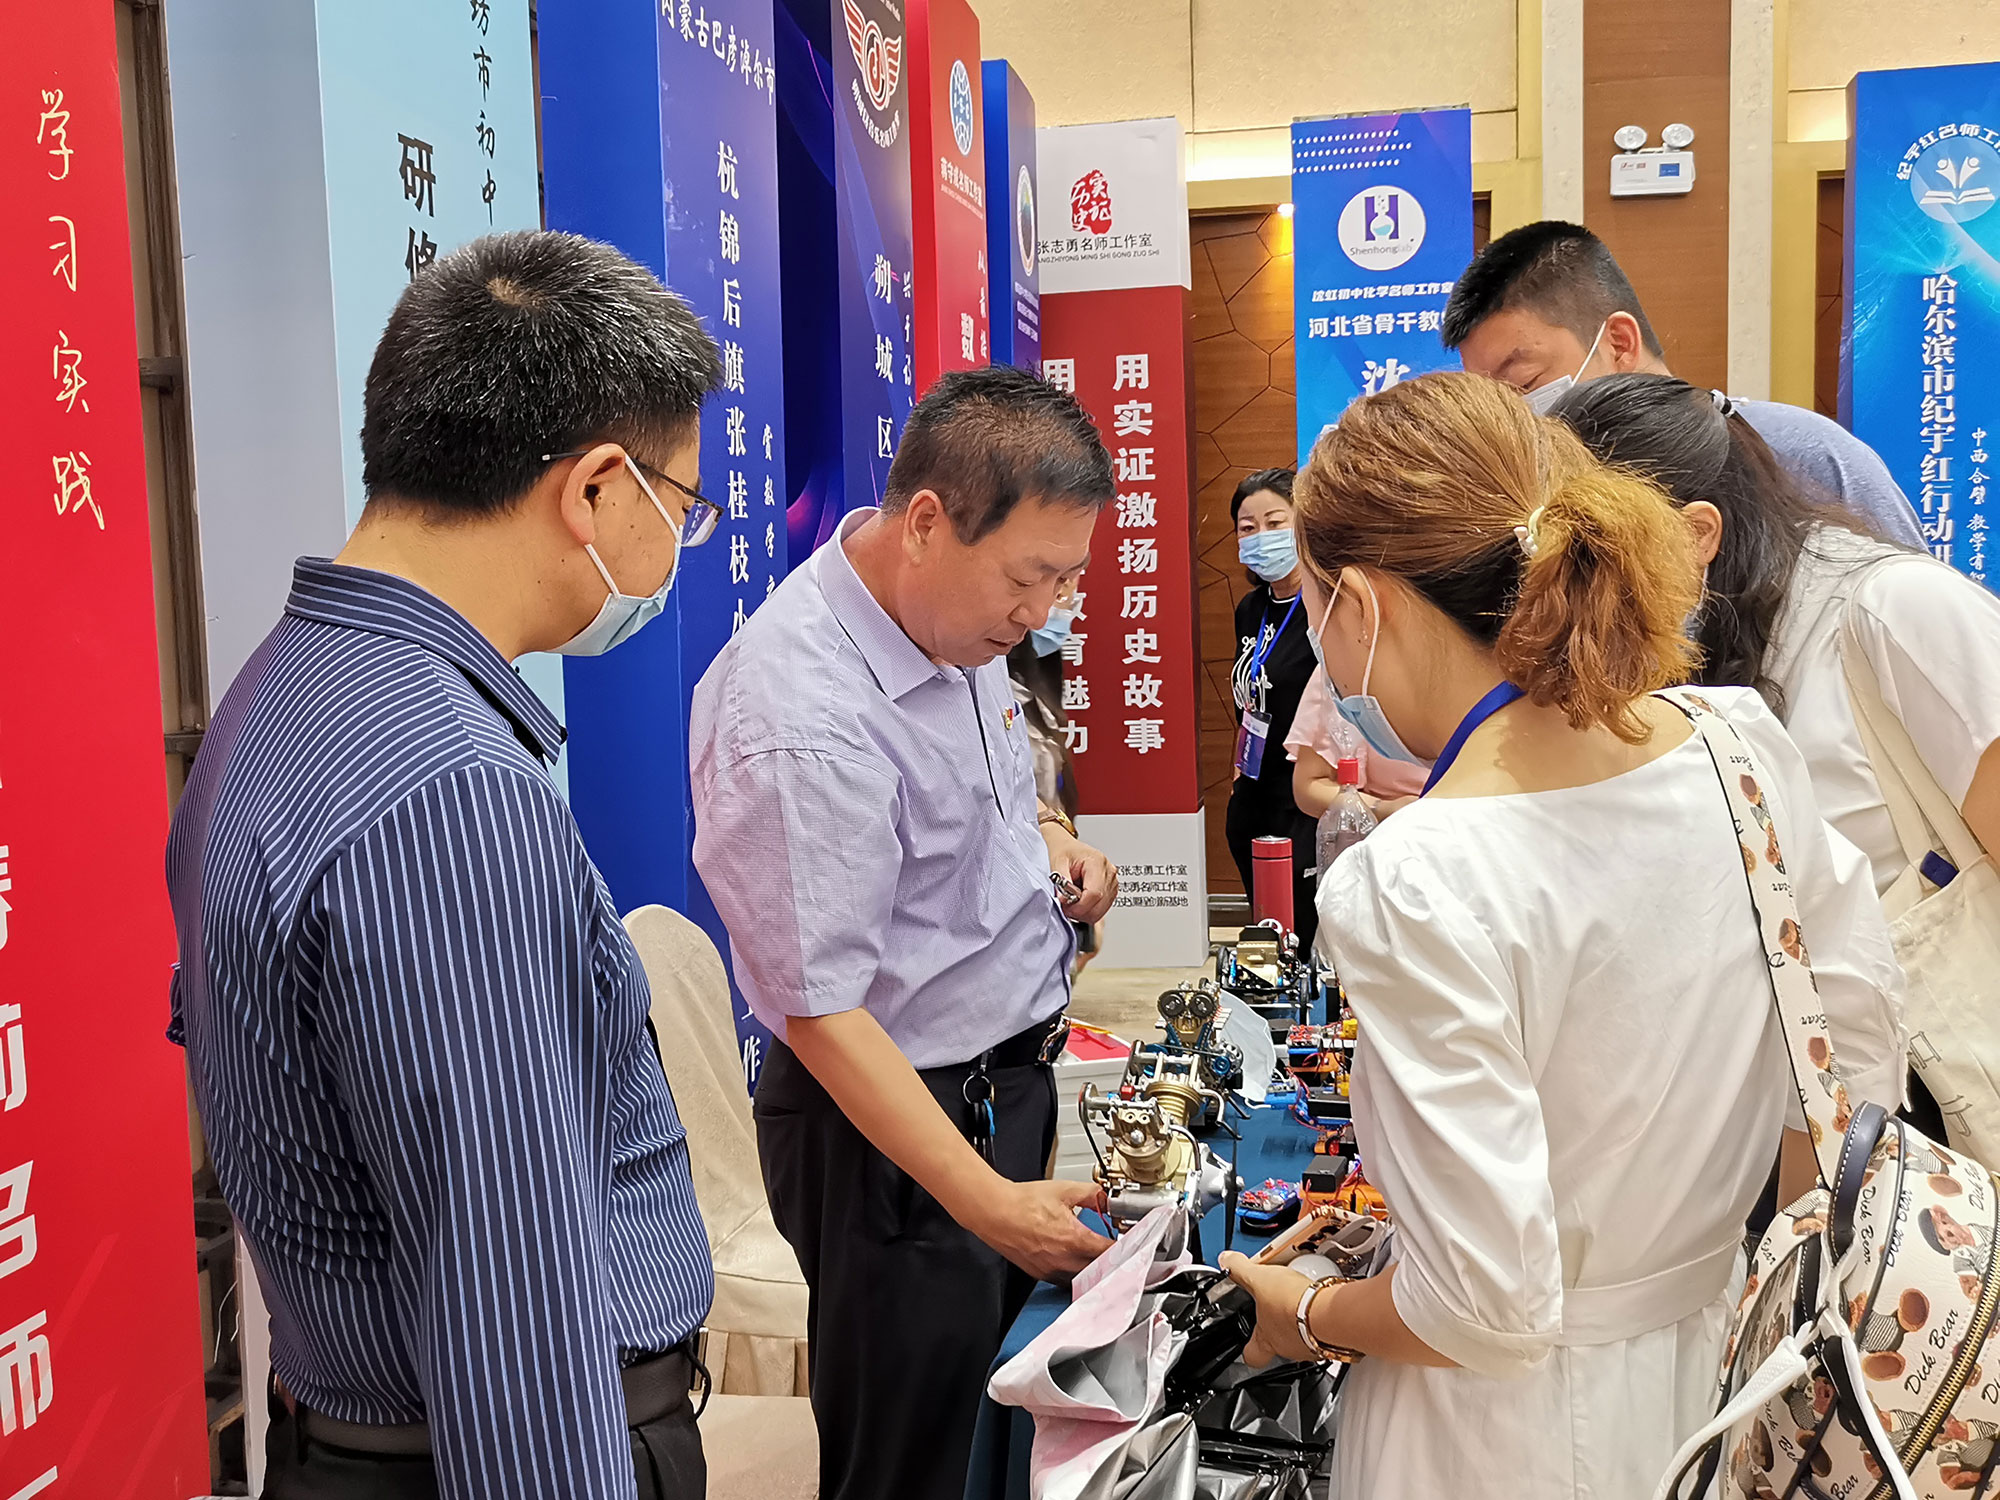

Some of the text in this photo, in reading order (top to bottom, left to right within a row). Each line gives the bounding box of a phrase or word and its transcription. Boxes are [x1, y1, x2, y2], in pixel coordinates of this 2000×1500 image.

[37, 88, 105, 531] 学习实践
[1036, 233, 1153, 256] 张志勇名师工作室
[874, 253, 894, 459] 朔城区
[1307, 309, 1446, 339] 河北省骨干教
[1112, 353, 1166, 755] 用实证激扬历史故事
[1903, 1308, 1960, 1396] Dick Bear
